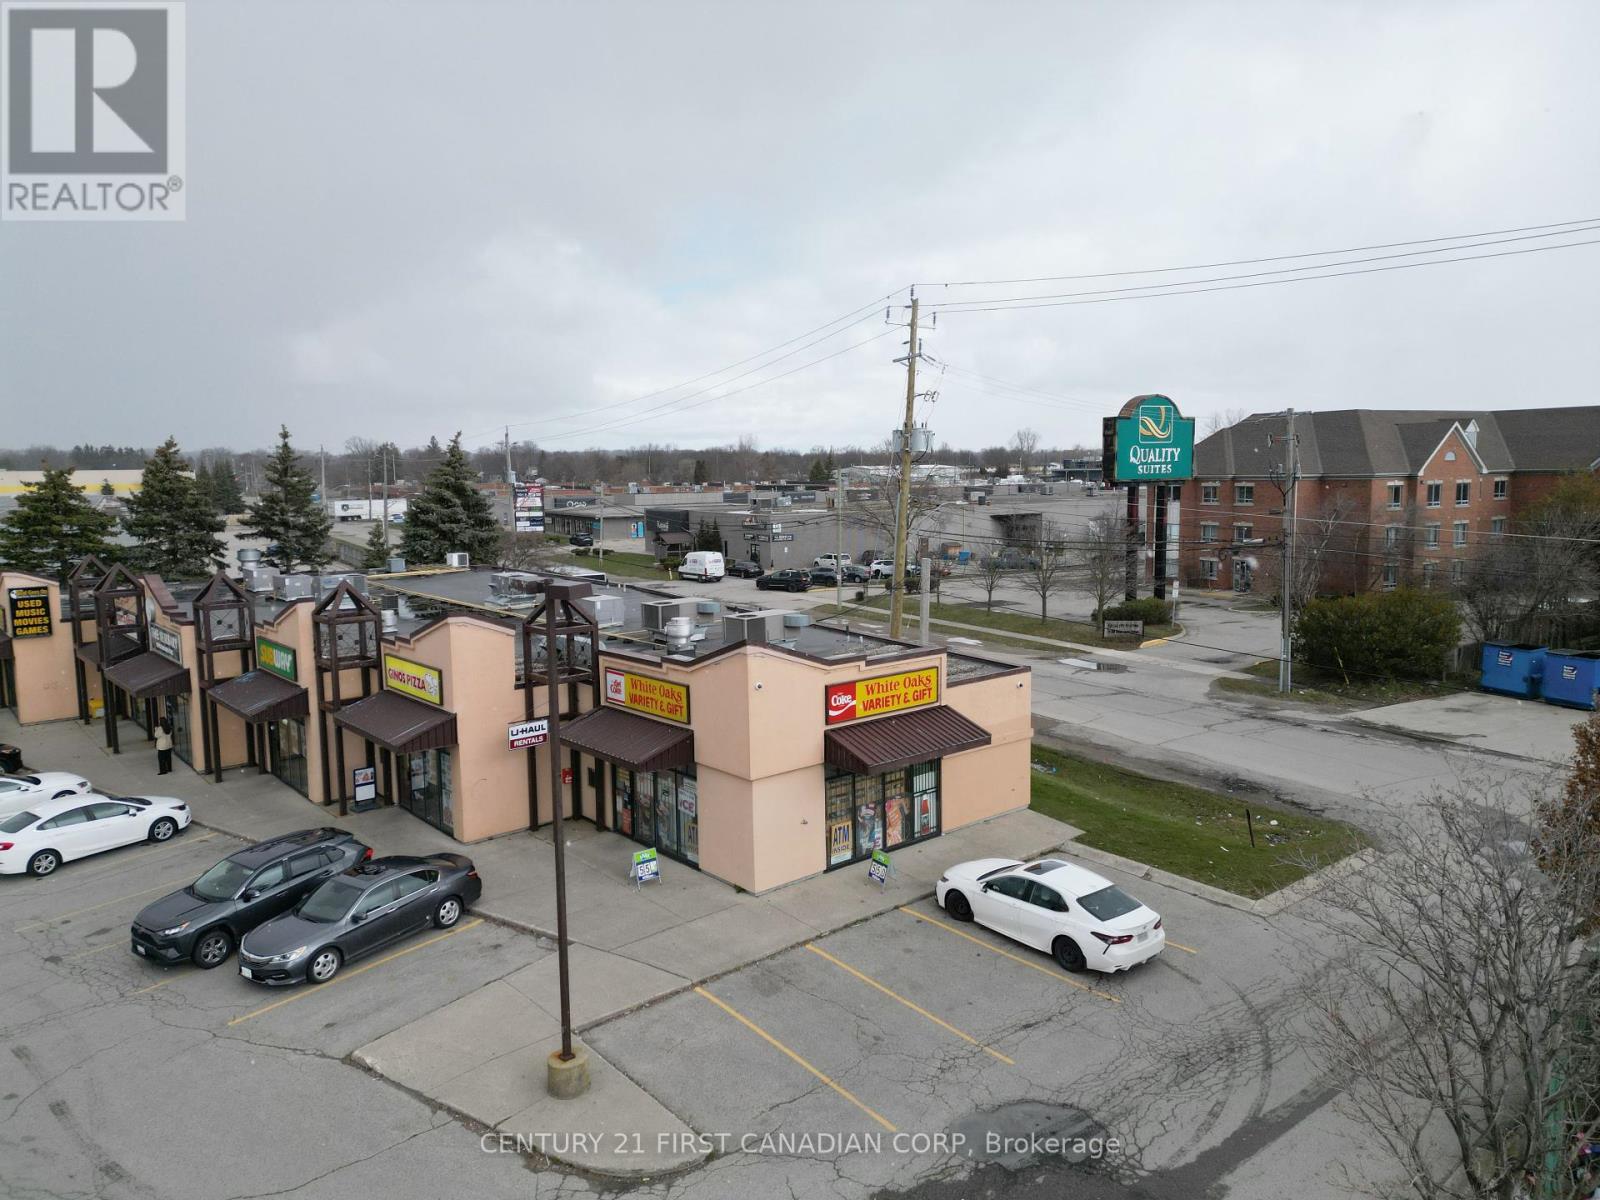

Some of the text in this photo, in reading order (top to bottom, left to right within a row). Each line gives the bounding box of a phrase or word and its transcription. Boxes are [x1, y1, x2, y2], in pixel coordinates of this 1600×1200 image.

[1129, 445, 1181, 465] QUALITY
[1137, 464, 1172, 474] SUITES
[17, 599, 42, 608] USED
[15, 608, 46, 618] MUSIC
[13, 617, 49, 627] MOVIES
[15, 626, 49, 635] GAMES
[261, 645, 292, 673] SUBWAY
[388, 667, 427, 691] GINOS PIZZA
[864, 675, 932, 696] White Oaks
[630, 678, 682, 703] White Oaks
[629, 692, 659, 711] VARIETY
[667, 702, 684, 717] GIFT
[831, 694, 853, 706] Coke
[862, 694, 901, 712] VARIETY
[912, 688, 932, 702] GIFT
[510, 724, 546, 736] U-HAUL
[513, 735, 544, 747] RENTALS
[833, 824, 850, 846] ATM
